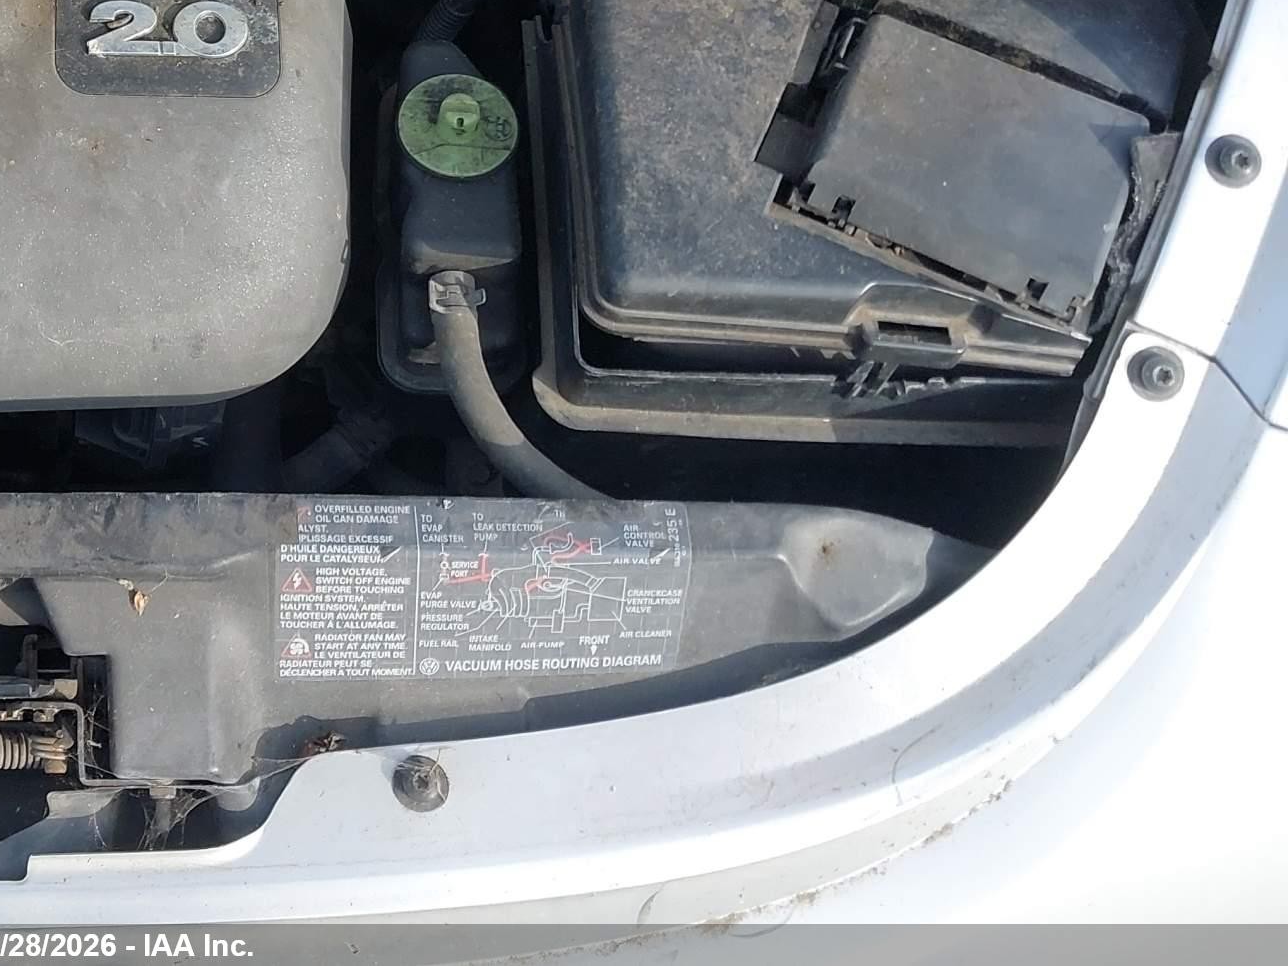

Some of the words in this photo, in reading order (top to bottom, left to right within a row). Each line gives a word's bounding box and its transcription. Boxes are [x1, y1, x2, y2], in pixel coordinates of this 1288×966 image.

[87, 0, 248, 58] 2.0
[314, 504, 372, 514] OVERFILLED
[374, 505, 411, 514] ENGINE
[315, 514, 332, 523] OIL
[333, 515, 355, 523] CAN
[356, 515, 399, 524] DAMAGE
[421, 514, 433, 523] TO
[472, 513, 484, 521] TO
[421, 524, 443, 533] EVAP
[473, 523, 494, 531] LEAK
[496, 523, 543, 532] DETECTION
[623, 524, 639, 532] AIR
[349, 534, 394, 544] EXCESSIF
[422, 534, 464, 543] CANISTER
[474, 533, 498, 542] PUMP
[624, 532, 666, 540] CONTROL
[280, 544, 318, 553] D'HUILE
[319, 544, 380, 554] DANGEREUX
[280, 554, 308, 563] POUR
[310, 554, 321, 563] LE
[451, 561, 479, 569] SERVICE
[315, 567, 340, 577] HIGH
[315, 577, 352, 585] SWITCH
[355, 577, 373, 585] OFF
[375, 577, 411, 586] ENGINE
[315, 586, 353, 594] BEFORE
[355, 586, 405, 594] TOUCHING
[280, 594, 323, 602] IGNITION
[420, 591, 442, 600] EVAP
[420, 600, 448, 609] PURGE
[450, 600, 477, 608] VALVE
[626, 597, 681, 605] VENTILATION
[280, 603, 317, 611] HAUTE
[361, 601, 404, 612] ARRÊTER
[625, 606, 651, 614] VALVE
[280, 612, 292, 620] LE
[293, 612, 335, 620] MOTEUR
[336, 612, 368, 620] AVANT
[370, 612, 383, 620] DE
[421, 614, 463, 622] PRESSURE
[280, 621, 325, 629] TOUCHER
[420, 623, 469, 631] REGULATOR
[314, 633, 362, 642] RADIATOR
[364, 633, 384, 641] FAN
[385, 633, 407, 641] MAY
[469, 634, 499, 643] INTAKE
[634, 630, 672, 638] CLEANER
[418, 640, 441, 648] FUEL
[440, 640, 459, 648] RAIL
[578, 634, 610, 645] FRONT
[314, 642, 345, 650] START
[468, 643, 512, 652] MANIFOLD
[314, 651, 326, 659] LE
[328, 651, 391, 659] VENTILATEUR
[392, 651, 406, 659] DE
[279, 660, 333, 668] RADIATEUR
[334, 660, 359, 668] PEUT
[360, 660, 373, 668] SE
[445, 659, 501, 672] VACUUM
[504, 659, 540, 671] HOSE
[542, 656, 599, 670] ROUTING
[602, 654, 662, 667] DIAGRAM
[346, 668, 369, 676] TOUT
